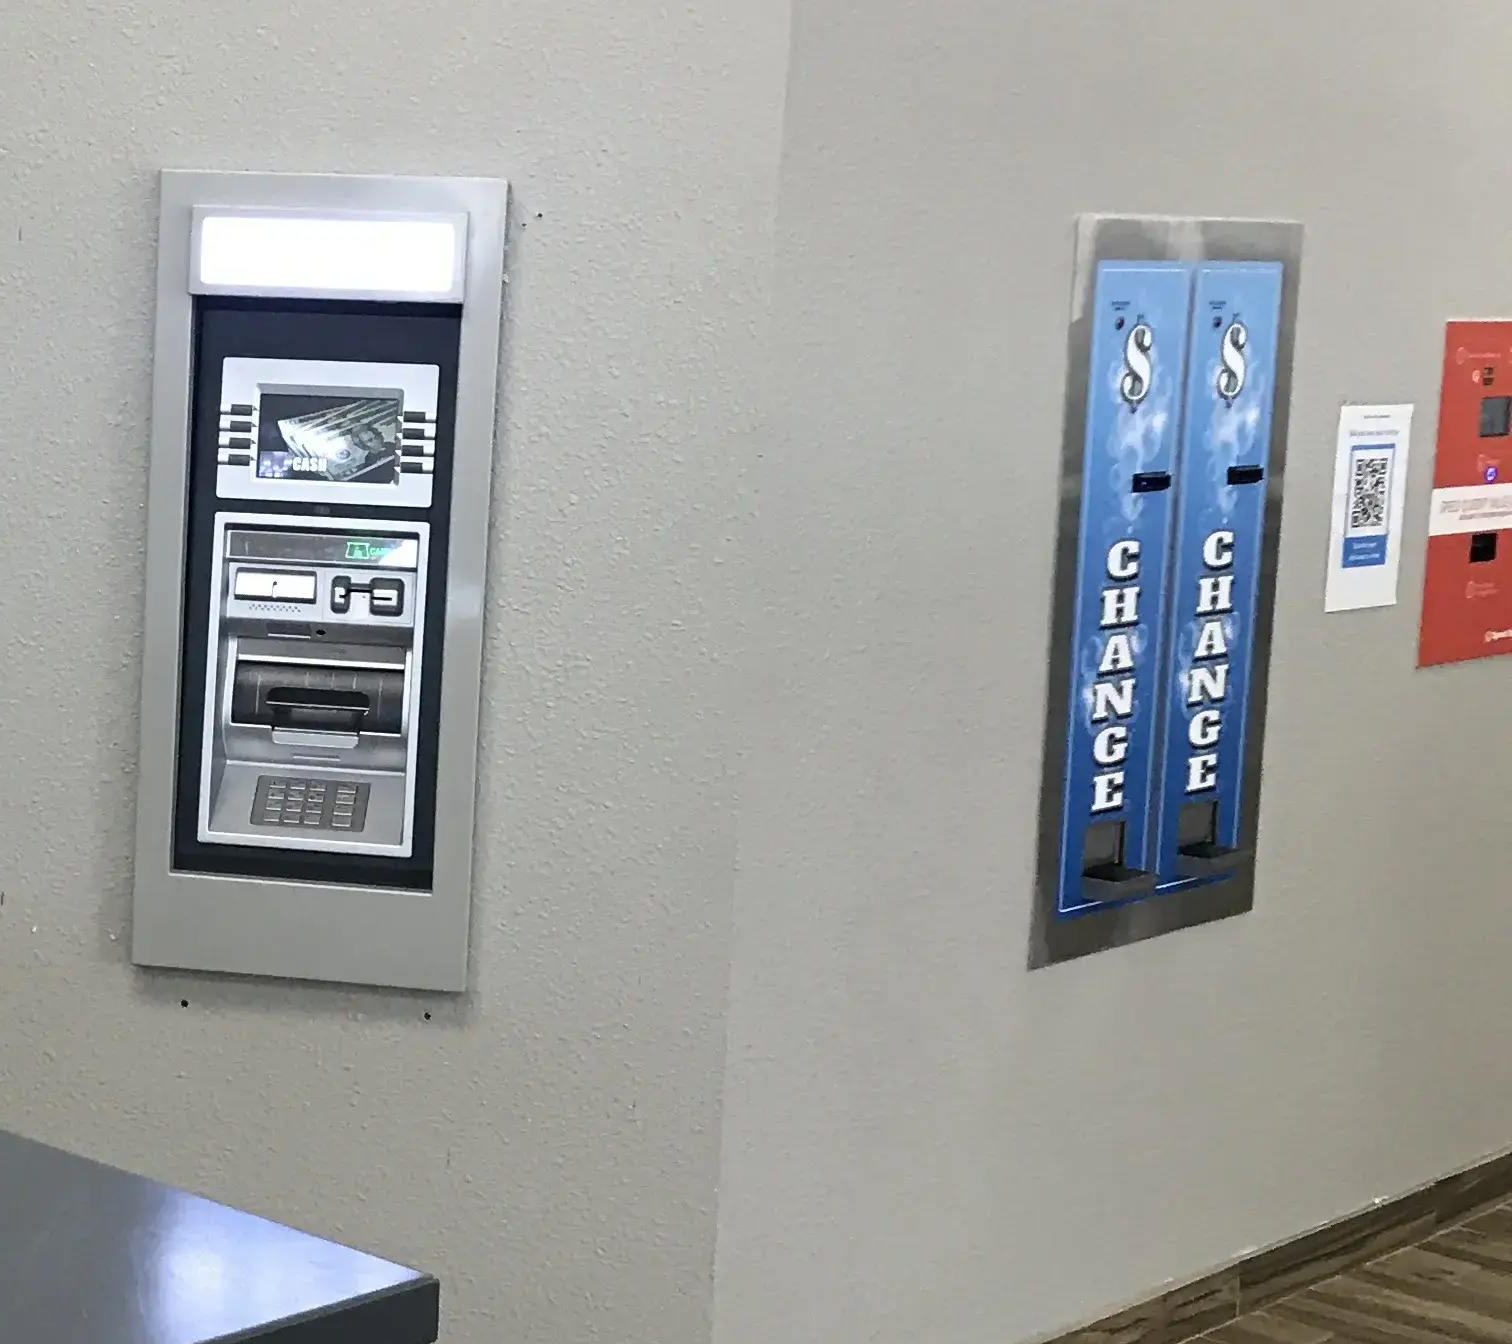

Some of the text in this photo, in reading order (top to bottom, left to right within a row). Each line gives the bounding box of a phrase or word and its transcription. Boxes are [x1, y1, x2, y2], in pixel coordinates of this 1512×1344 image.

[292, 456, 328, 472] CASH
[1089, 539, 1143, 813] CHANGE
[1185, 529, 1235, 795] CHANGE
